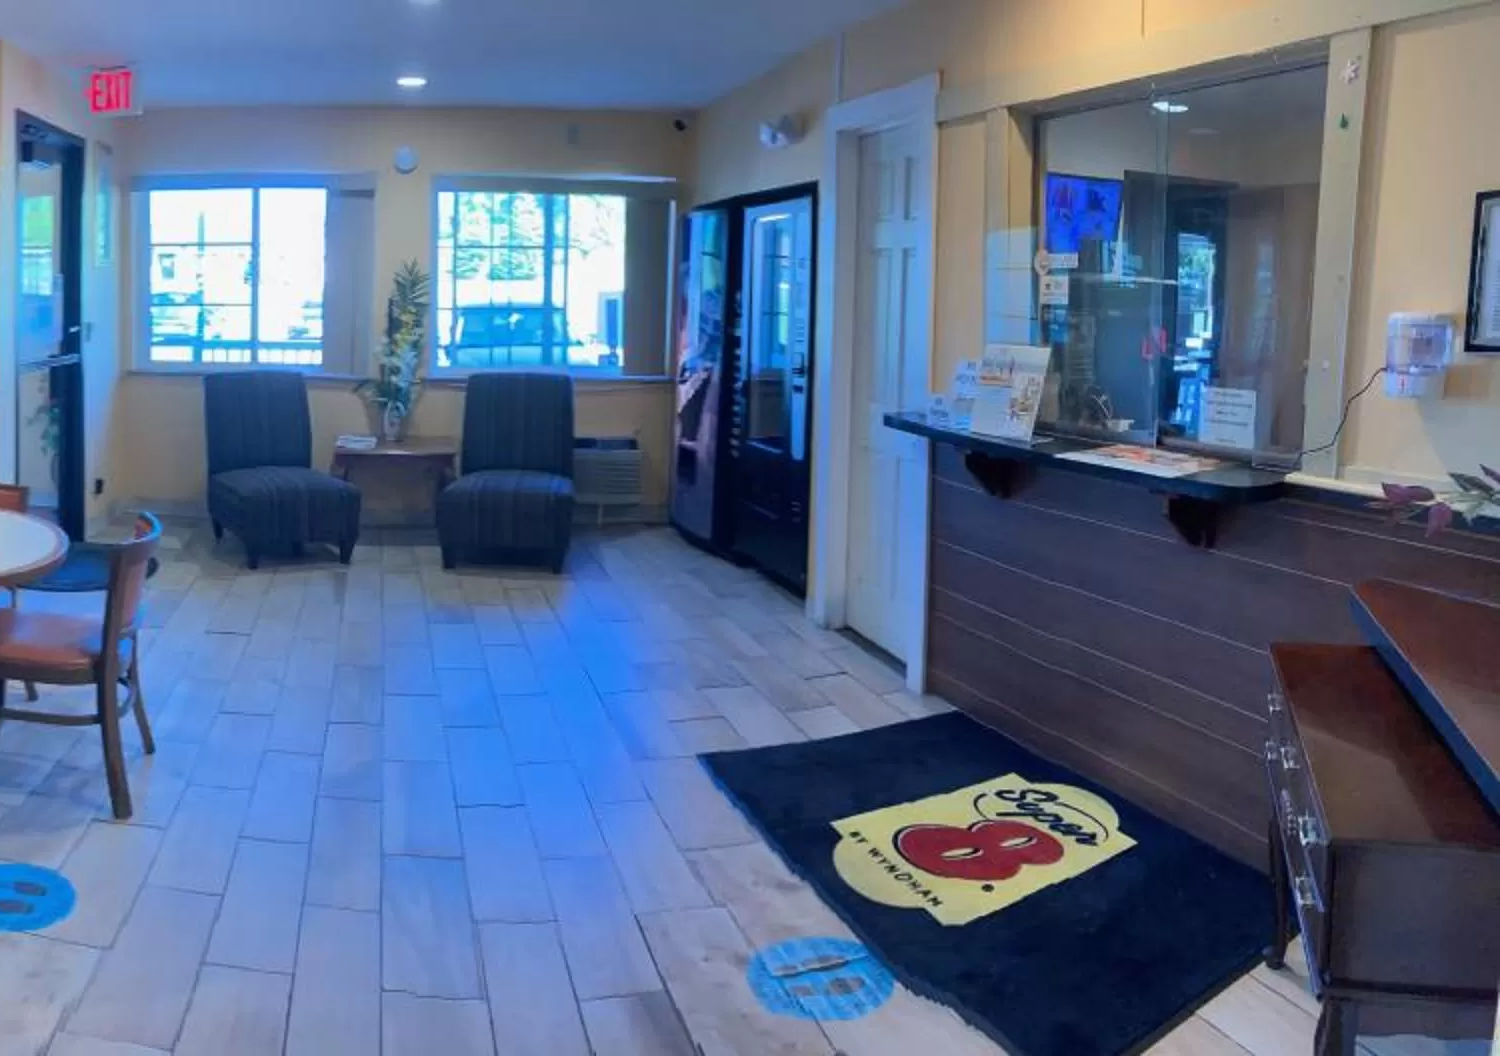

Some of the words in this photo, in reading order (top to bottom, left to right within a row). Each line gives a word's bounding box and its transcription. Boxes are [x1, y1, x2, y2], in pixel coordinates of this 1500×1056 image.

[91, 71, 132, 112] EXIT
[995, 788, 1100, 847] Super
[849, 830, 869, 844] BY
[867, 846, 944, 908] WYNDHAM
[892, 819, 1065, 881] 8
